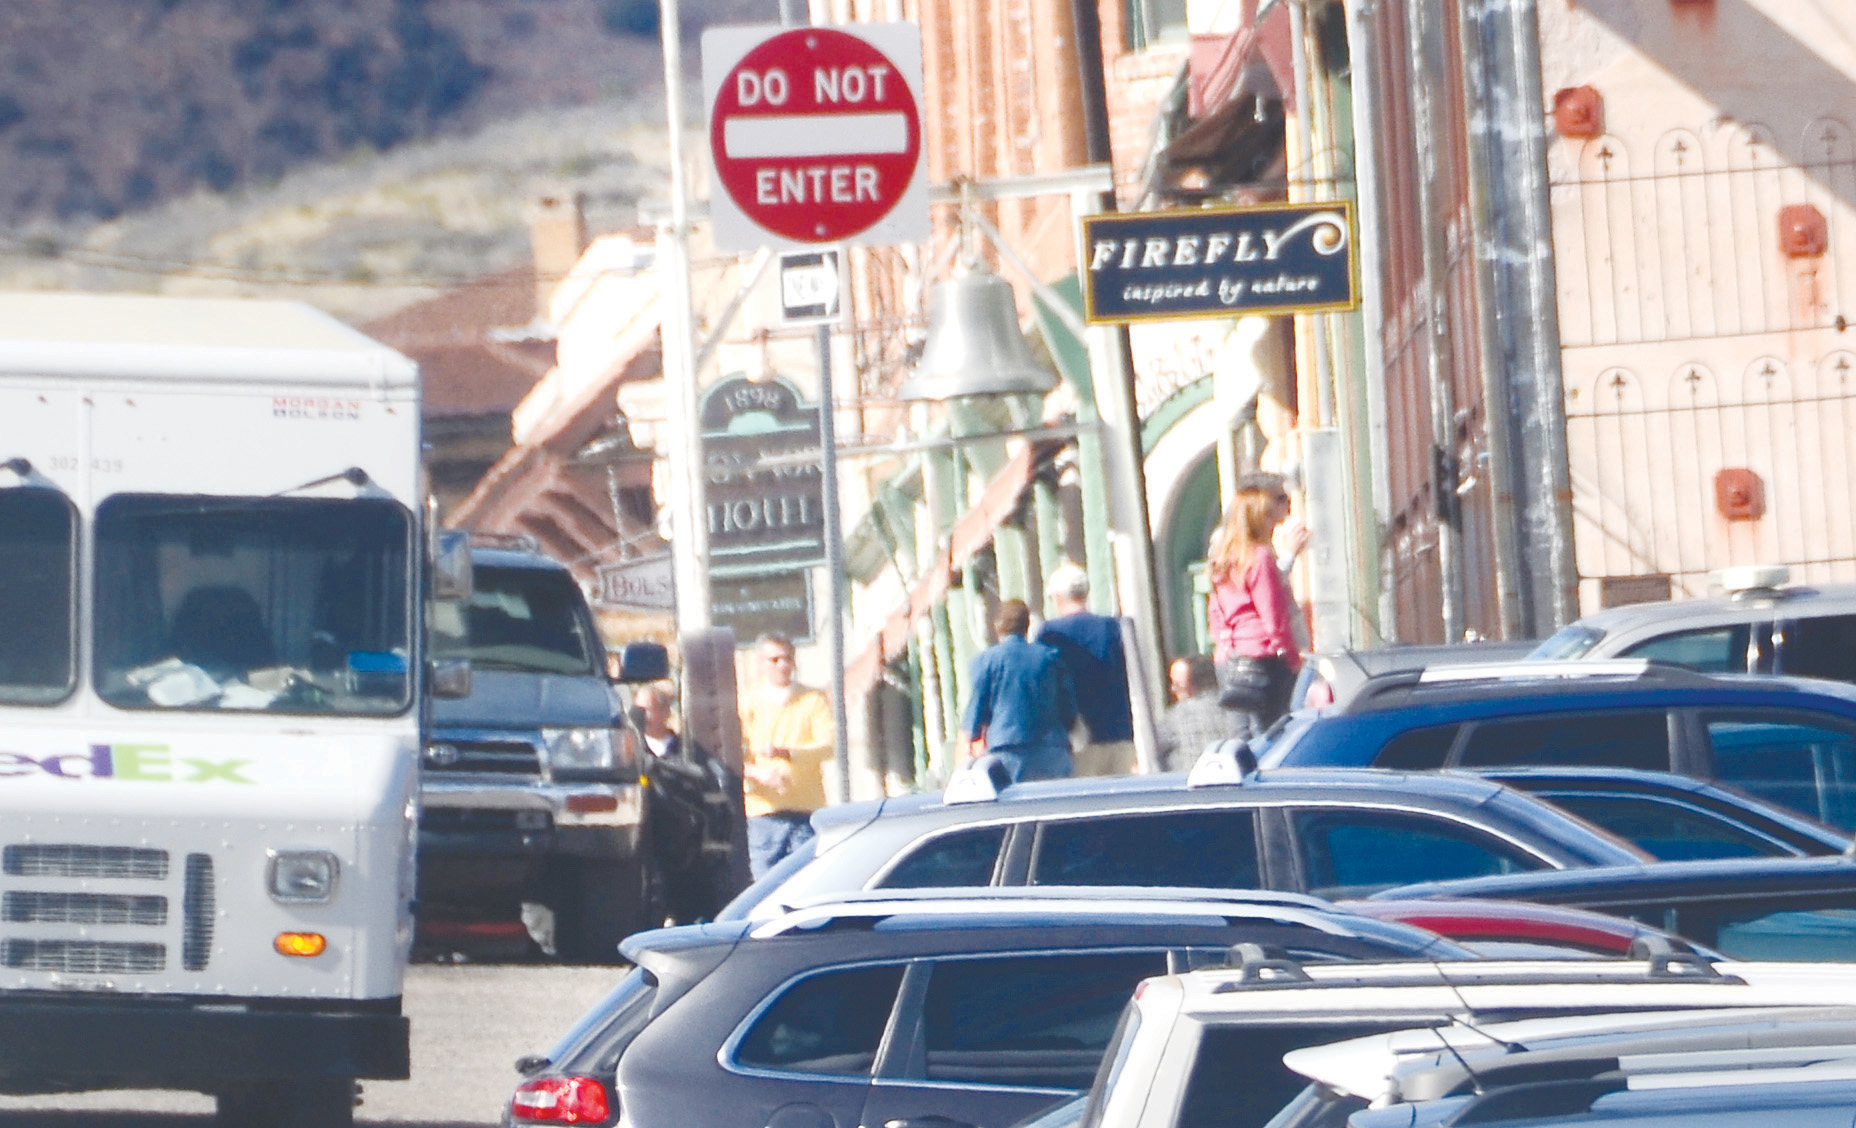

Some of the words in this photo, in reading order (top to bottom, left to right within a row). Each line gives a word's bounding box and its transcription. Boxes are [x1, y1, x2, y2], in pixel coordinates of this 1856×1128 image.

[736, 69, 789, 107] DO
[813, 65, 888, 104] NOT
[756, 165, 880, 205] ENTER
[1089, 222, 1300, 271] FIREFLY
[1122, 279, 1210, 303] inspired
[1218, 276, 1244, 305] by
[1250, 273, 1319, 295] nature
[724, 386, 780, 412] 1898
